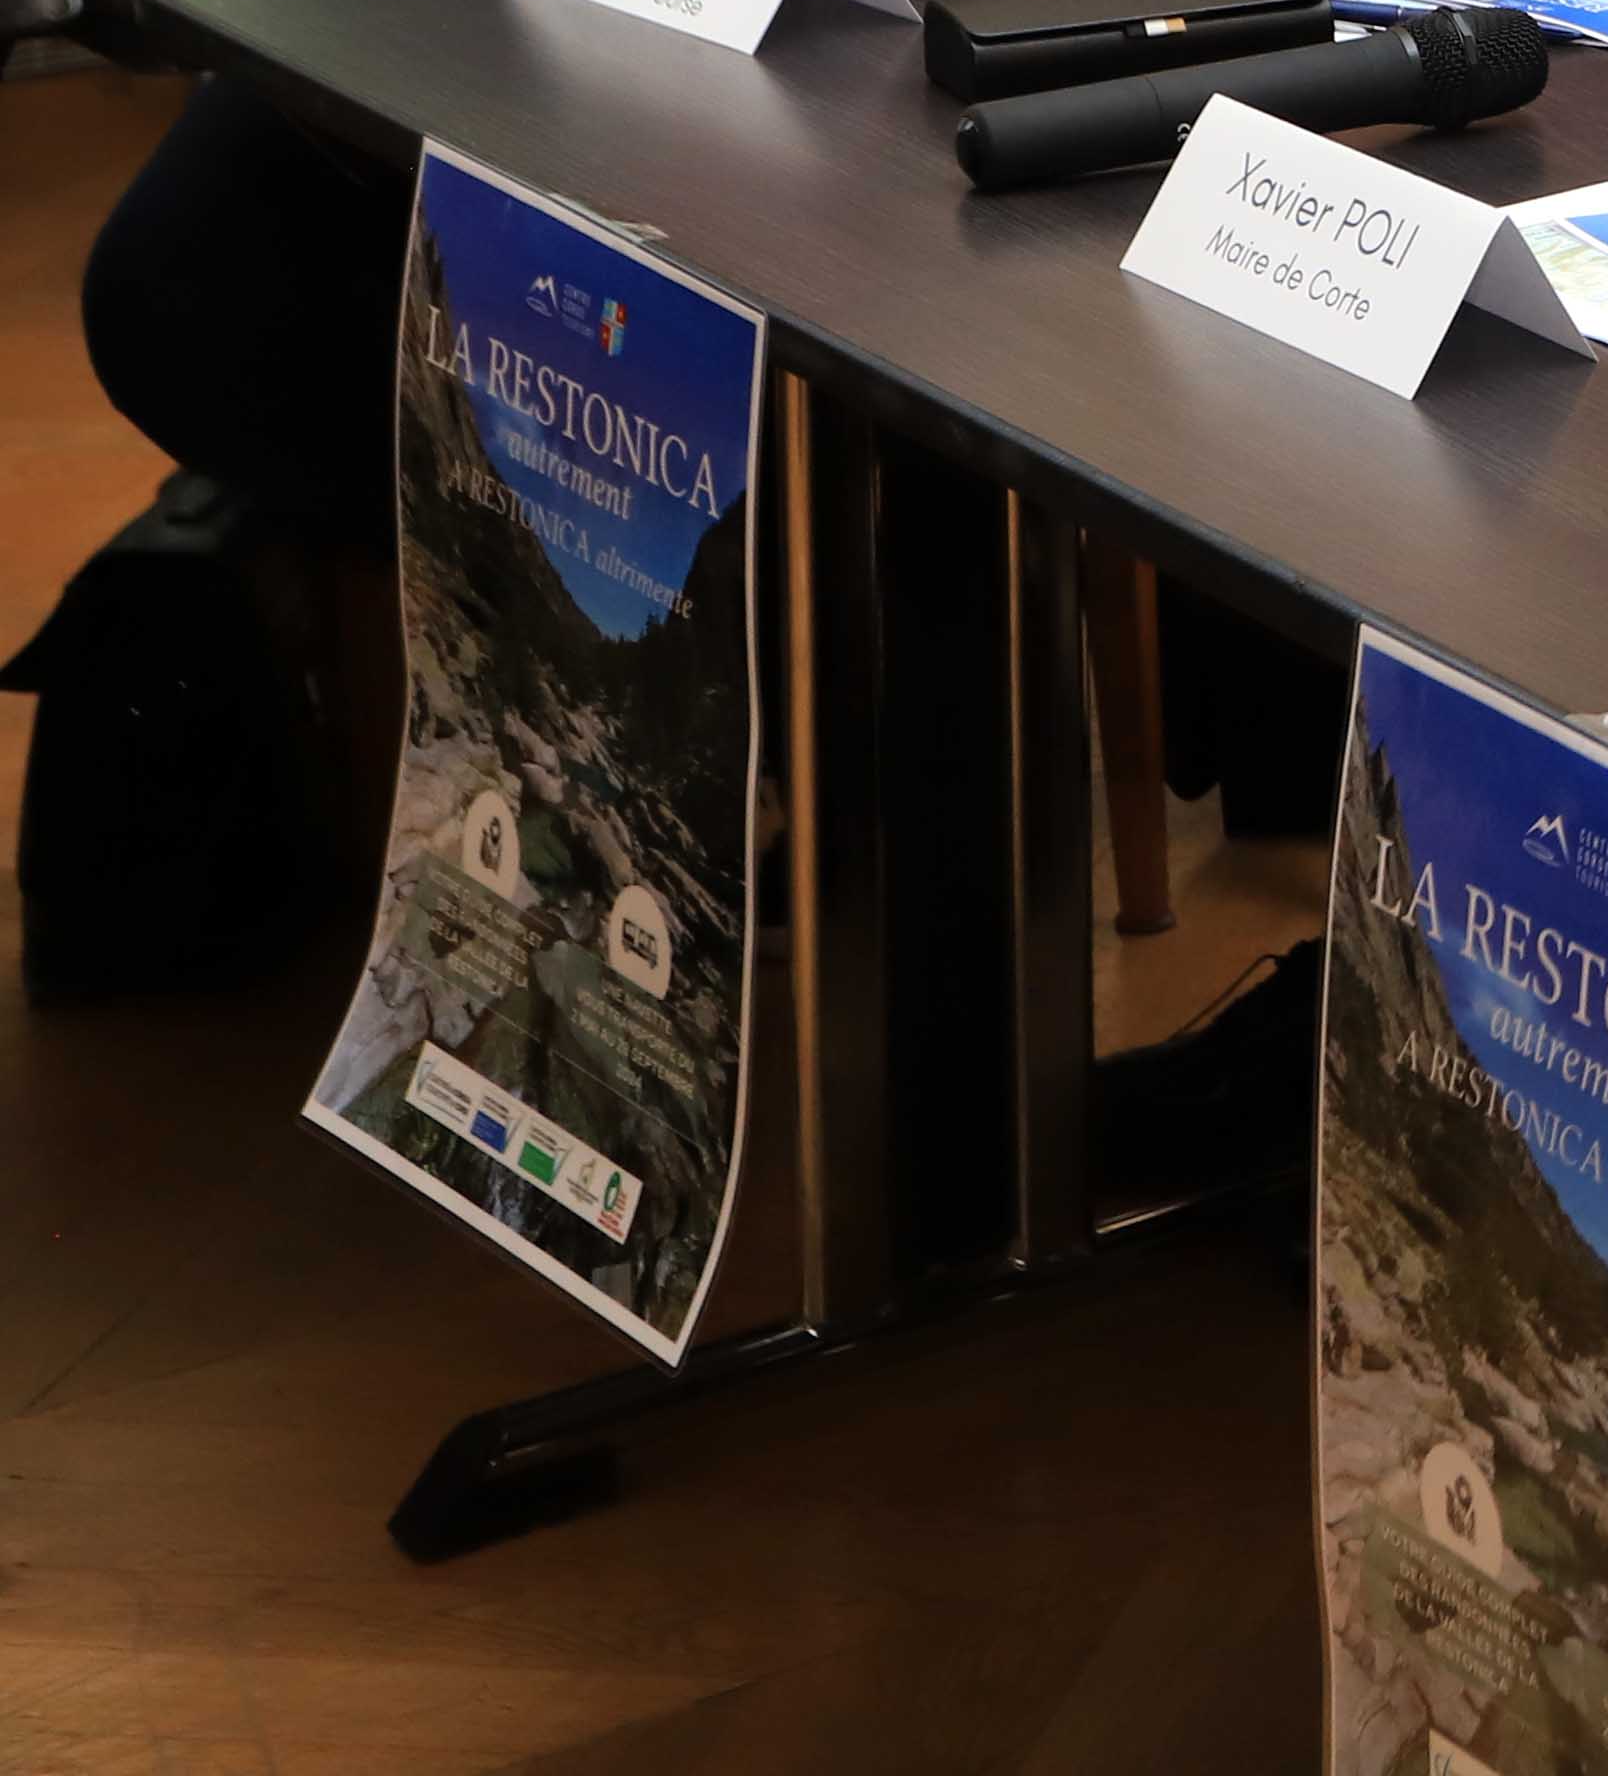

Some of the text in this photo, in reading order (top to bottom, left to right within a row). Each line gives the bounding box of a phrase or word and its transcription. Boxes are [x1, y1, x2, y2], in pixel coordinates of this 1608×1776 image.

[1225, 151, 1421, 270] Xavier POLI
[1204, 224, 1371, 321] Maire de Corte
[424, 303, 721, 521] LA RESTONICA
[505, 429, 633, 522] autrement
[468, 463, 592, 565] RESTONICA
[594, 545, 695, 620] altrimente
[1369, 834, 1445, 943] LA
[1397, 1029, 1422, 1075] A
[1428, 1045, 1602, 1184] RESTONICA
